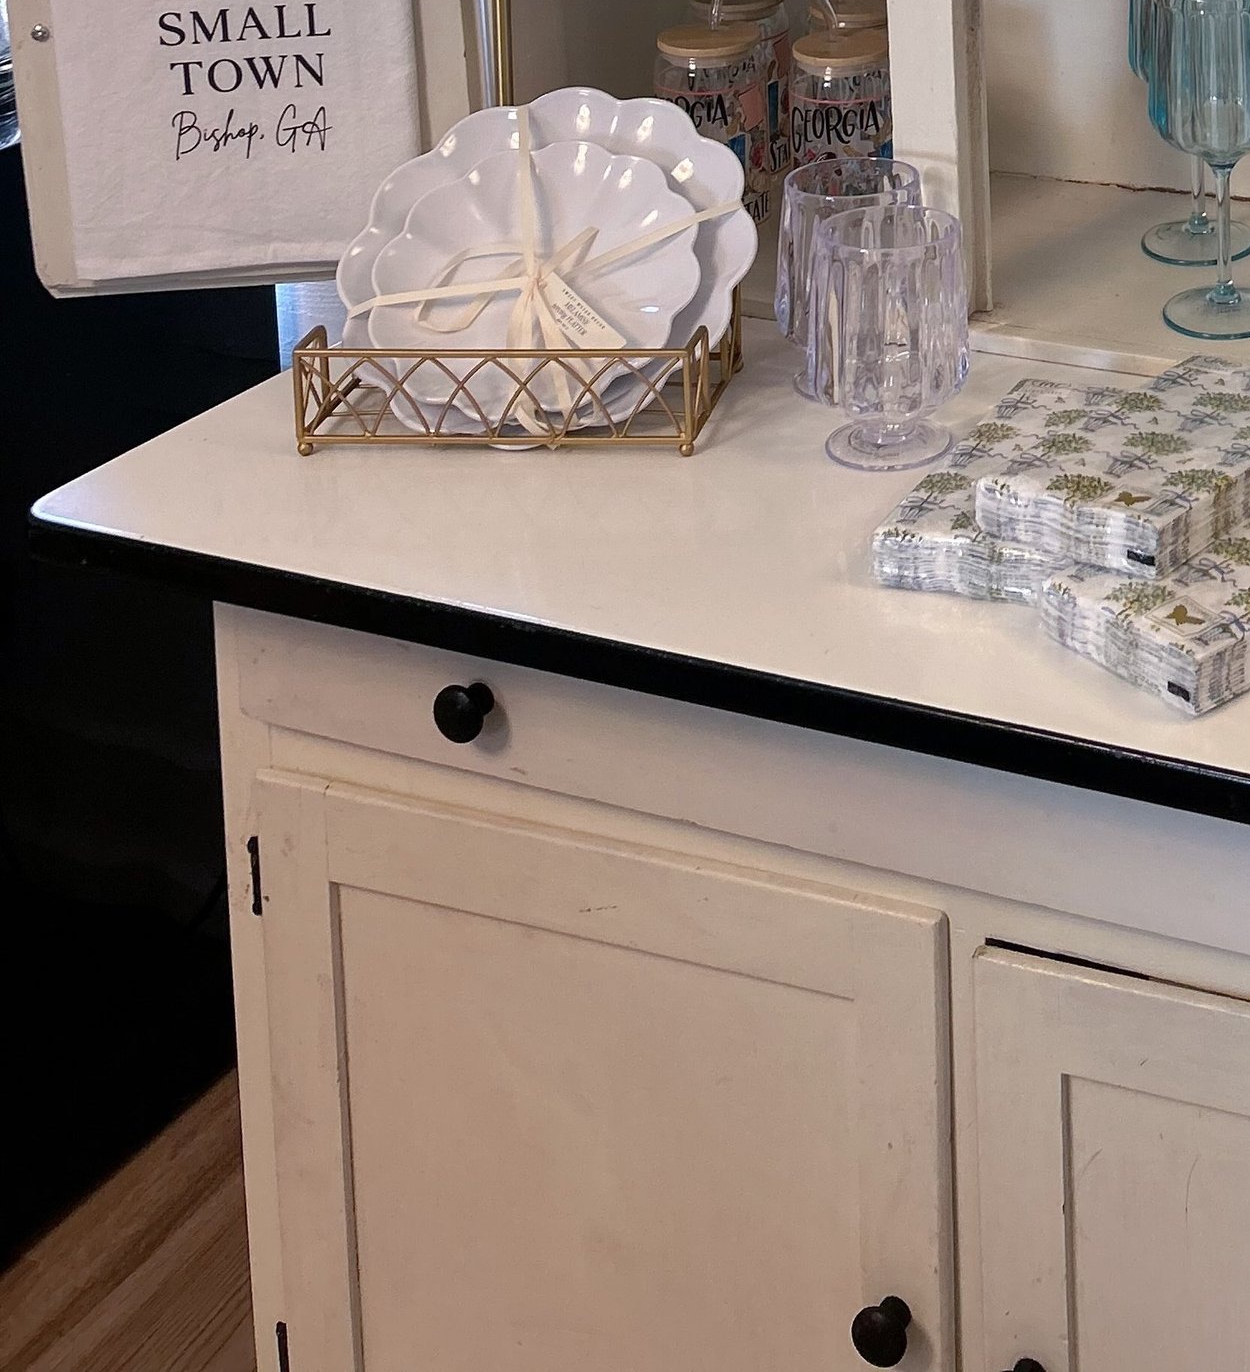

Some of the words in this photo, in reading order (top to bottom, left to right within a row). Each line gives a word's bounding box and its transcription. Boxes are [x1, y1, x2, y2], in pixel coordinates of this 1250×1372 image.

[158, 3, 331, 46] SMALL
[170, 52, 324, 95] TOWN
[275, 104, 333, 154] GA
[791, 100, 880, 153] GEORGIA
[741, 190, 769, 221] TATE
